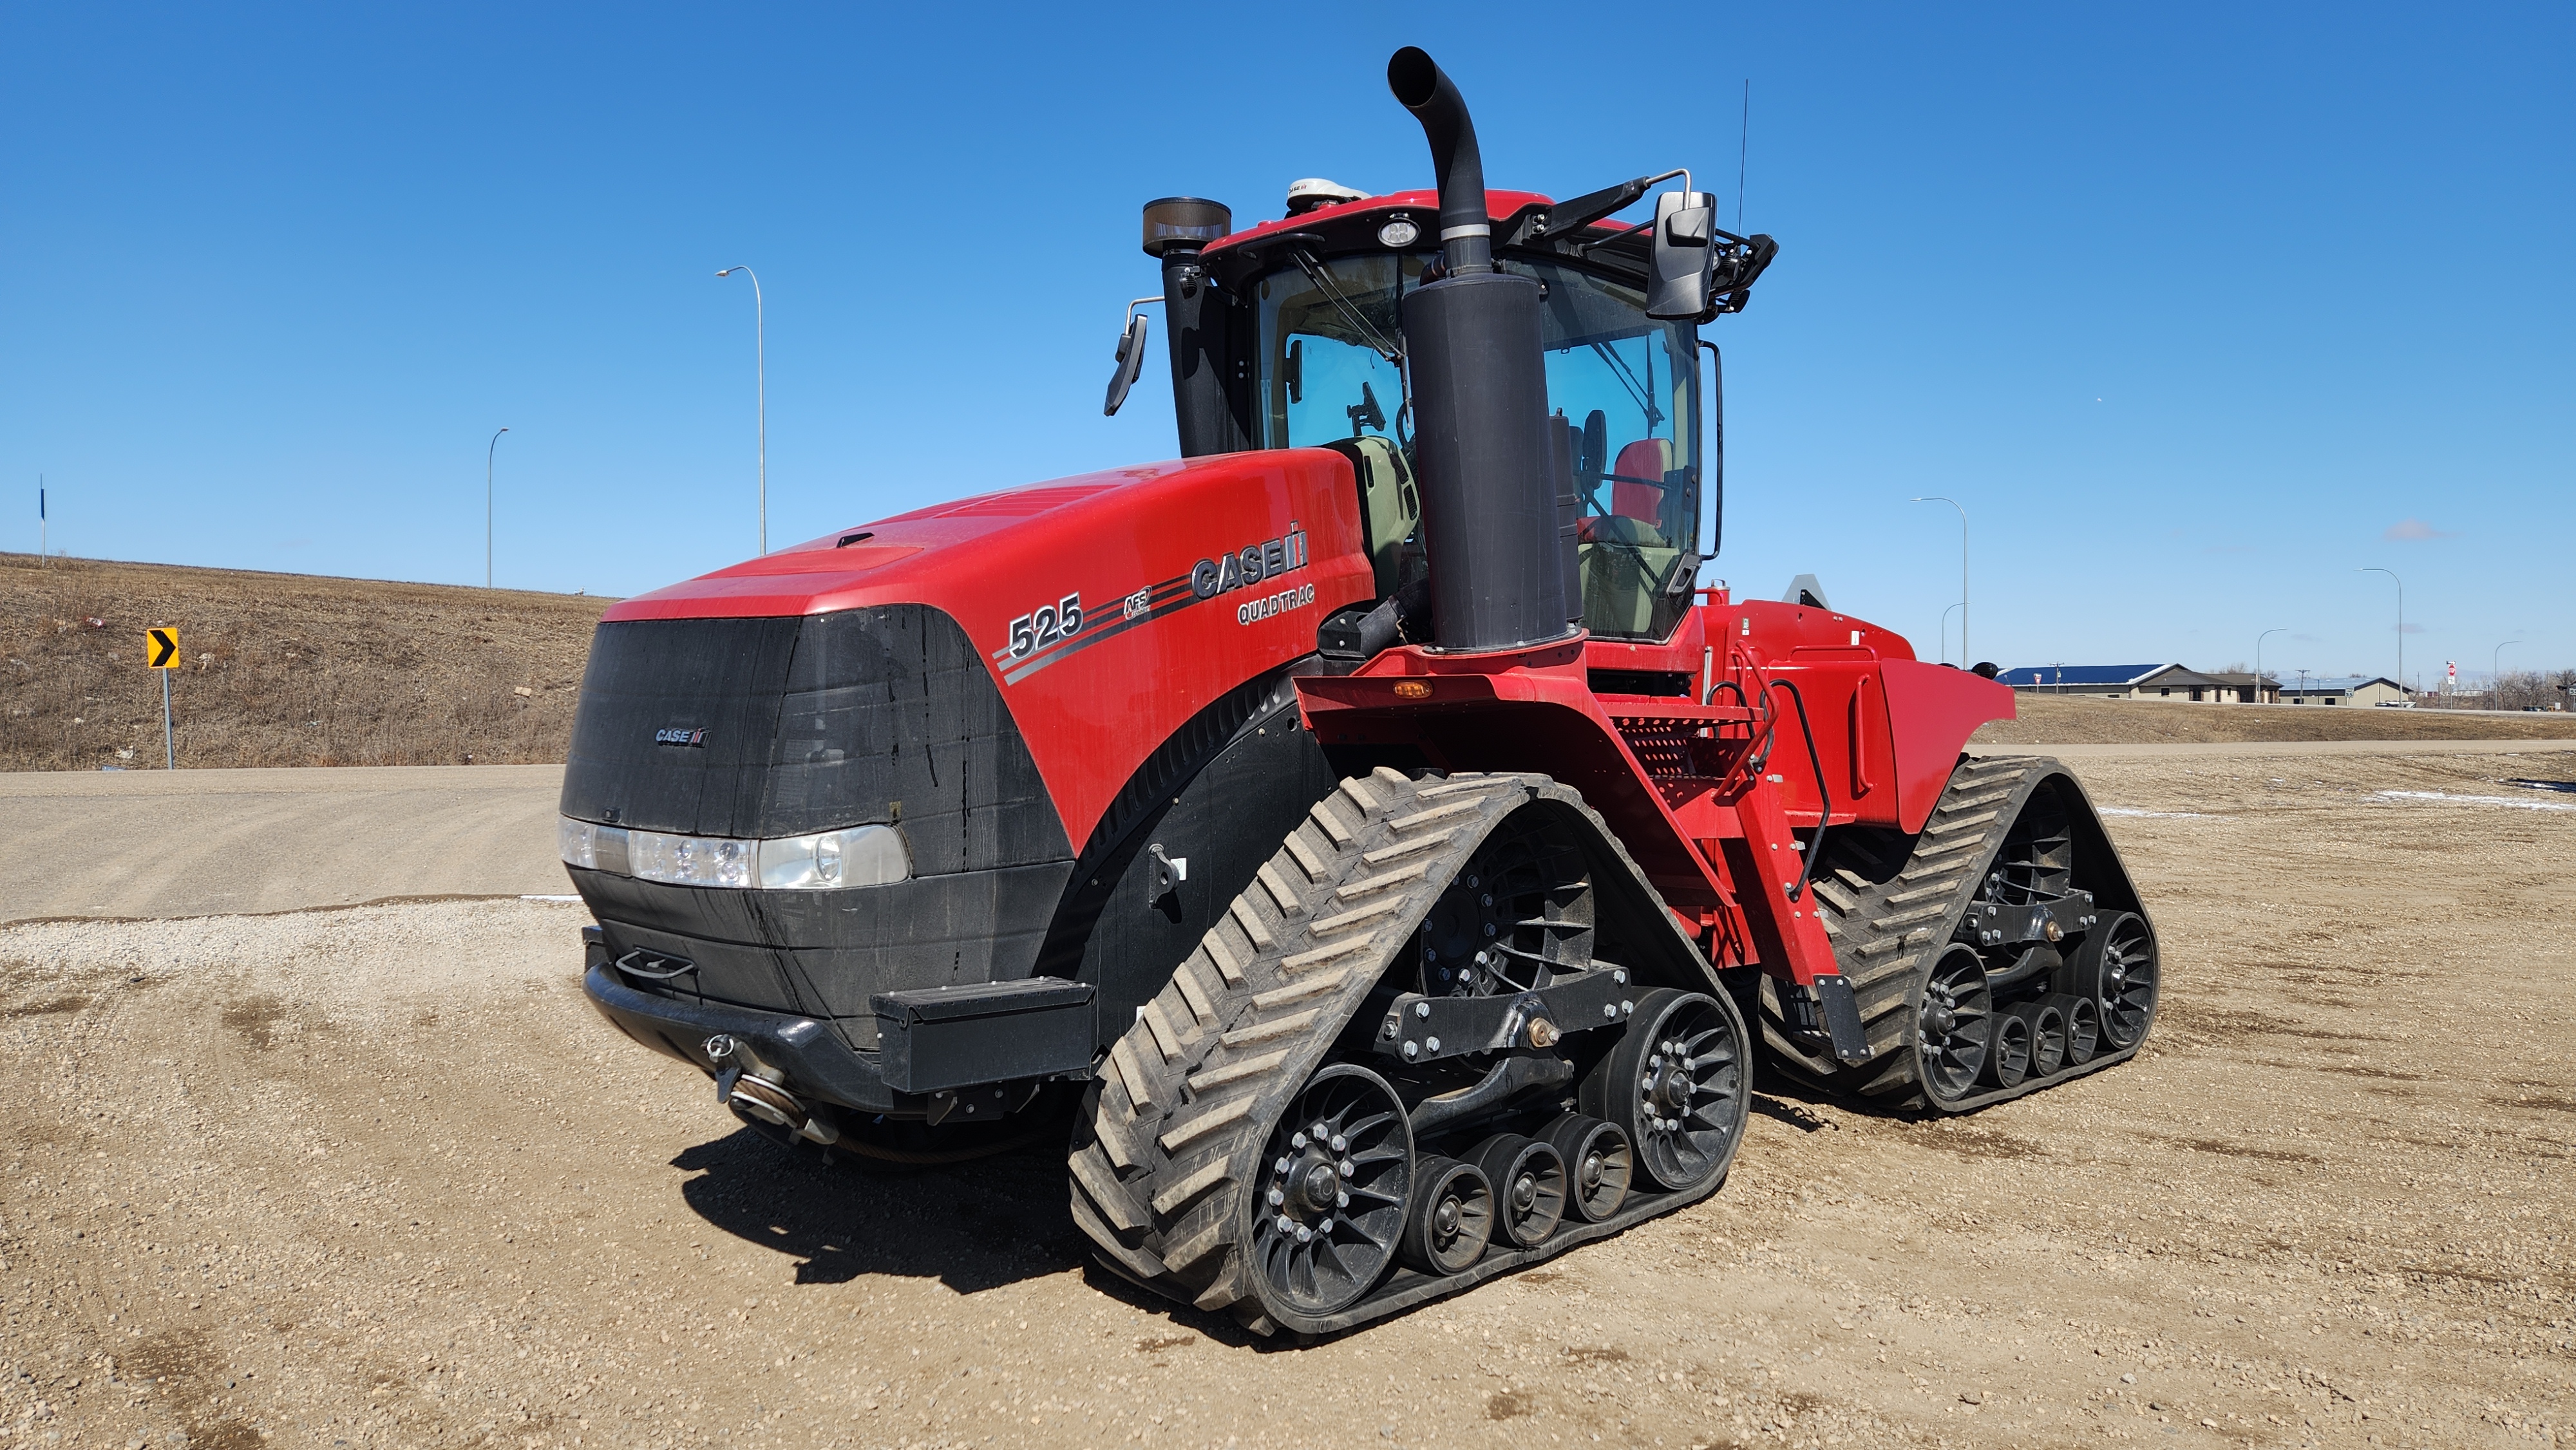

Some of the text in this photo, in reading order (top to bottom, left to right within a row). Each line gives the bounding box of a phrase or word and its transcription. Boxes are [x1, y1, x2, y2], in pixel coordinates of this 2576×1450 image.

[1191, 539, 1283, 599] CASE
[1124, 590, 1147, 615] AFS
[1238, 584, 1314, 625] QUADTRAC
[1009, 592, 1083, 659] 525
[656, 729, 690, 742] CASE
